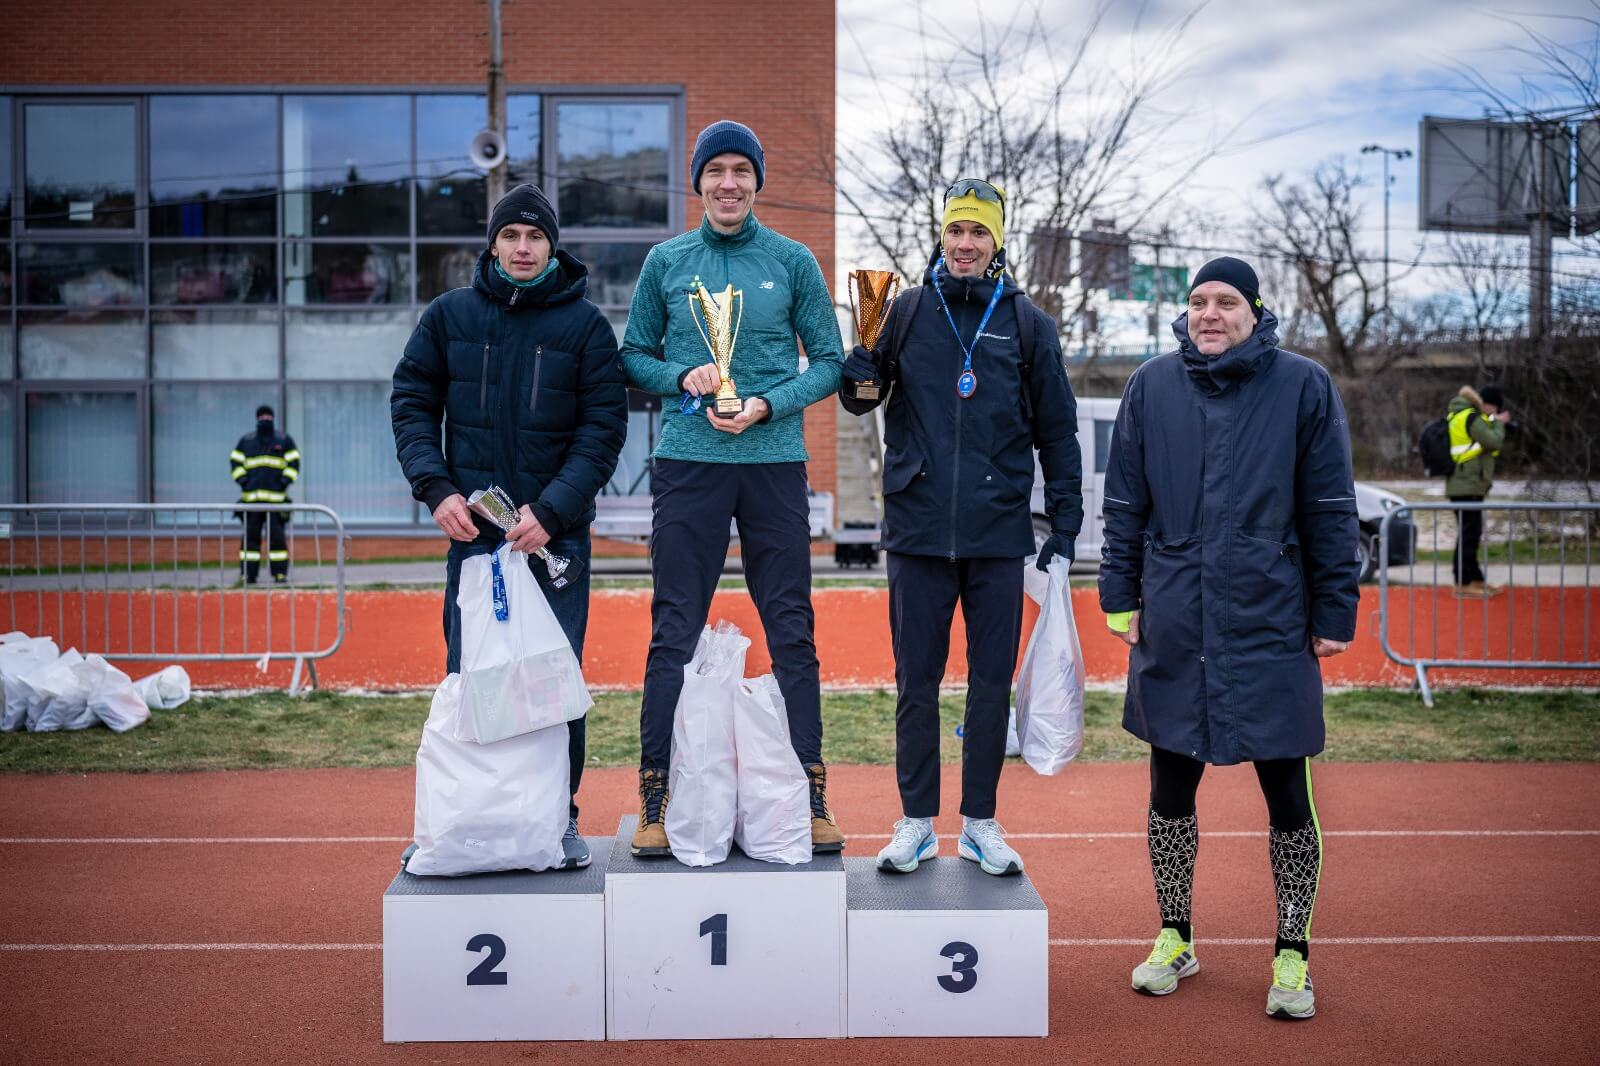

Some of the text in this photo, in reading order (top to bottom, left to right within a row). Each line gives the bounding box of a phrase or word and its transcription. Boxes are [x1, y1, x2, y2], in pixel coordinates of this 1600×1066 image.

[465, 933, 508, 986] 2
[699, 913, 728, 966] 1
[936, 941, 979, 994] 3
